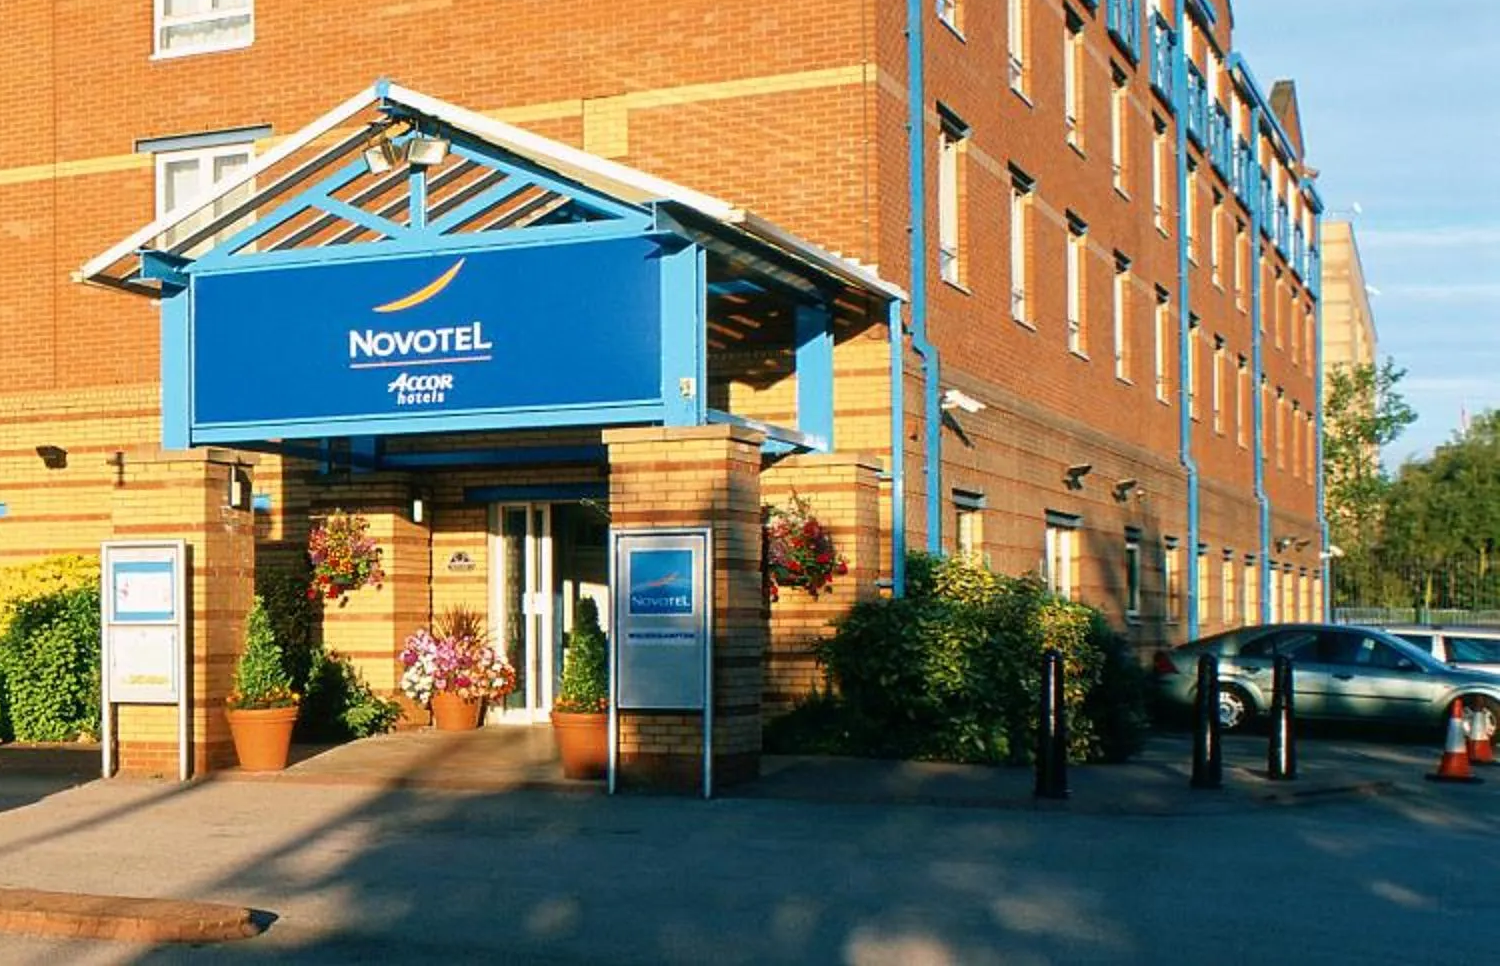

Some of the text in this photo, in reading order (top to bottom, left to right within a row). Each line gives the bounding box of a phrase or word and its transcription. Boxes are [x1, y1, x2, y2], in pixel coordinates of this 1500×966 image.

[349, 321, 493, 358] NOVOTEL
[397, 390, 445, 405] hotels
[631, 594, 691, 608] NOVOTEL
